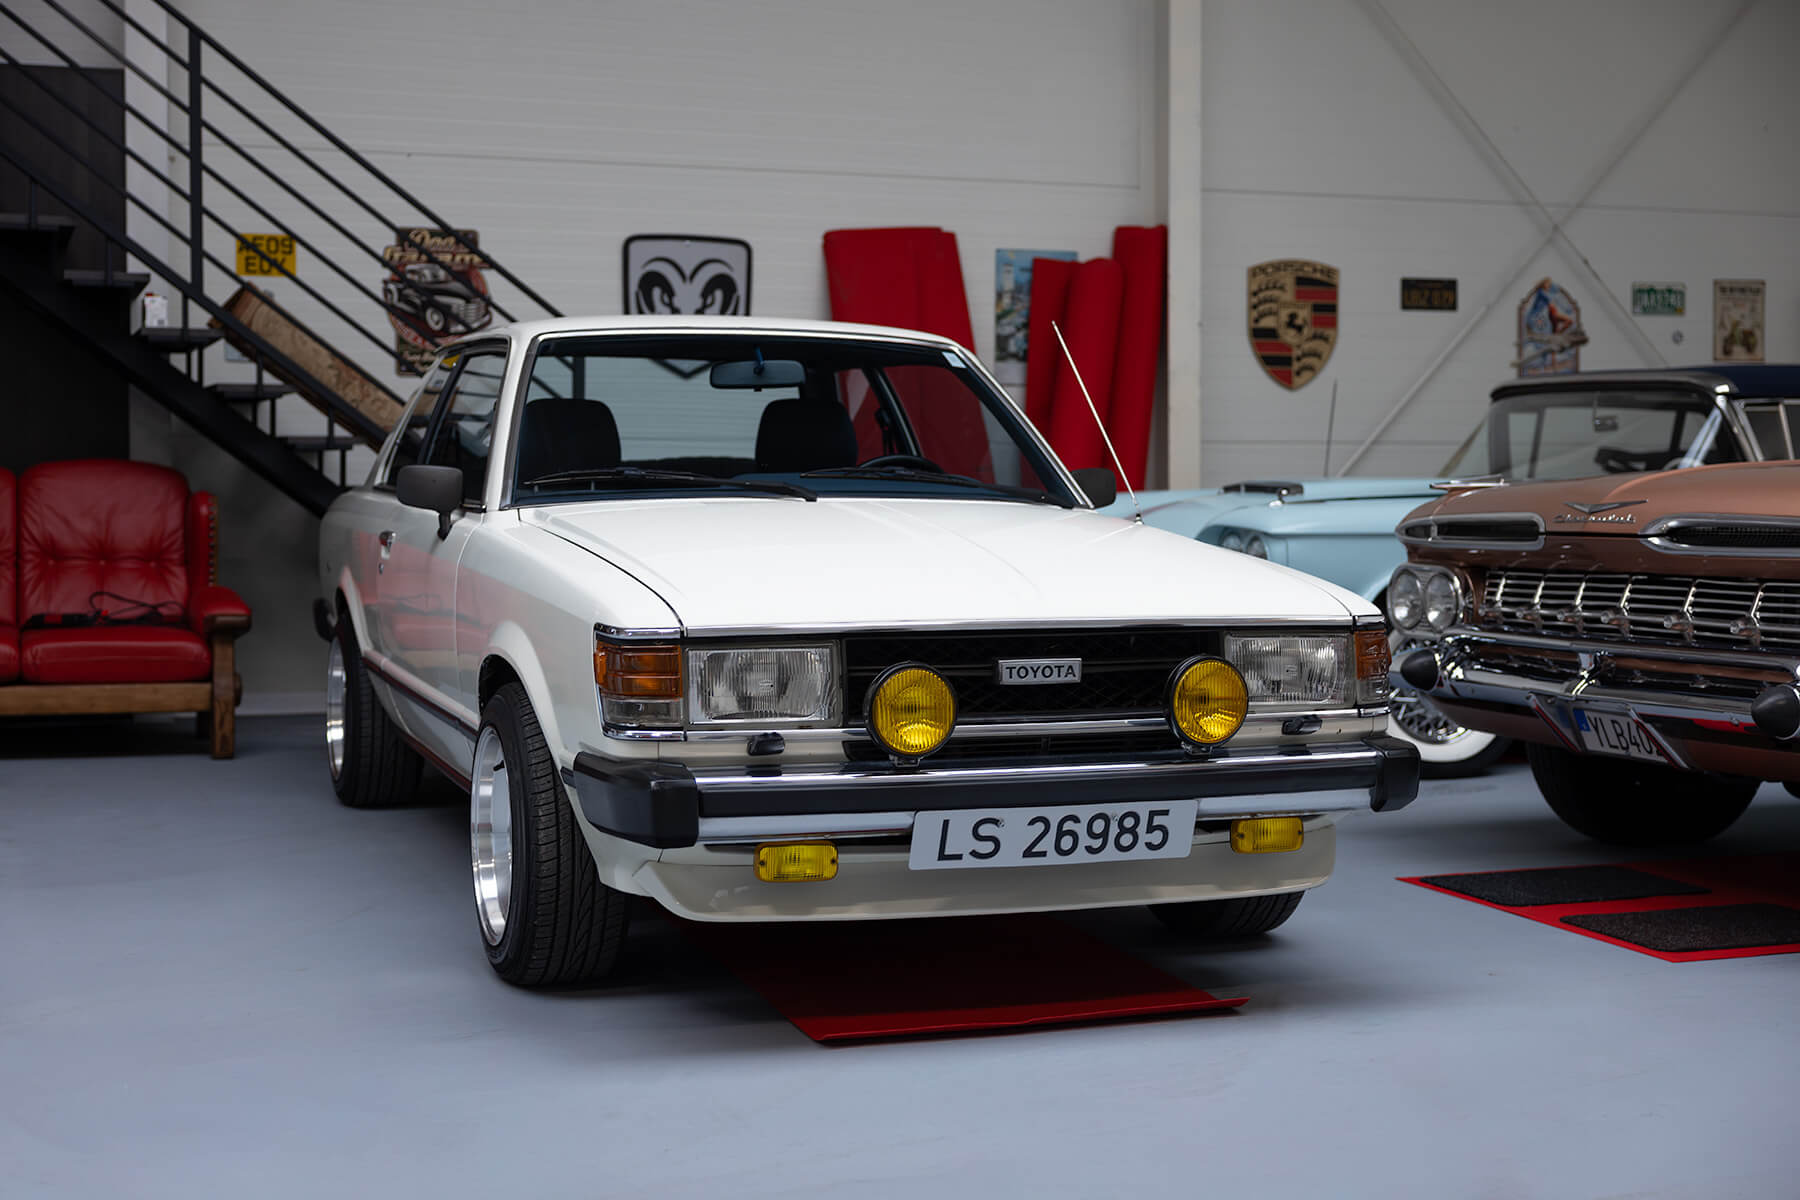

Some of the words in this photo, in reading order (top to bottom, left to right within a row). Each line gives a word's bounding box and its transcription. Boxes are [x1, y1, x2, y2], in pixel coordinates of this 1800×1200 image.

[1005, 665, 1076, 679] TOYOTA
[937, 817, 1004, 861] LS
[1022, 809, 1170, 858] 26985
